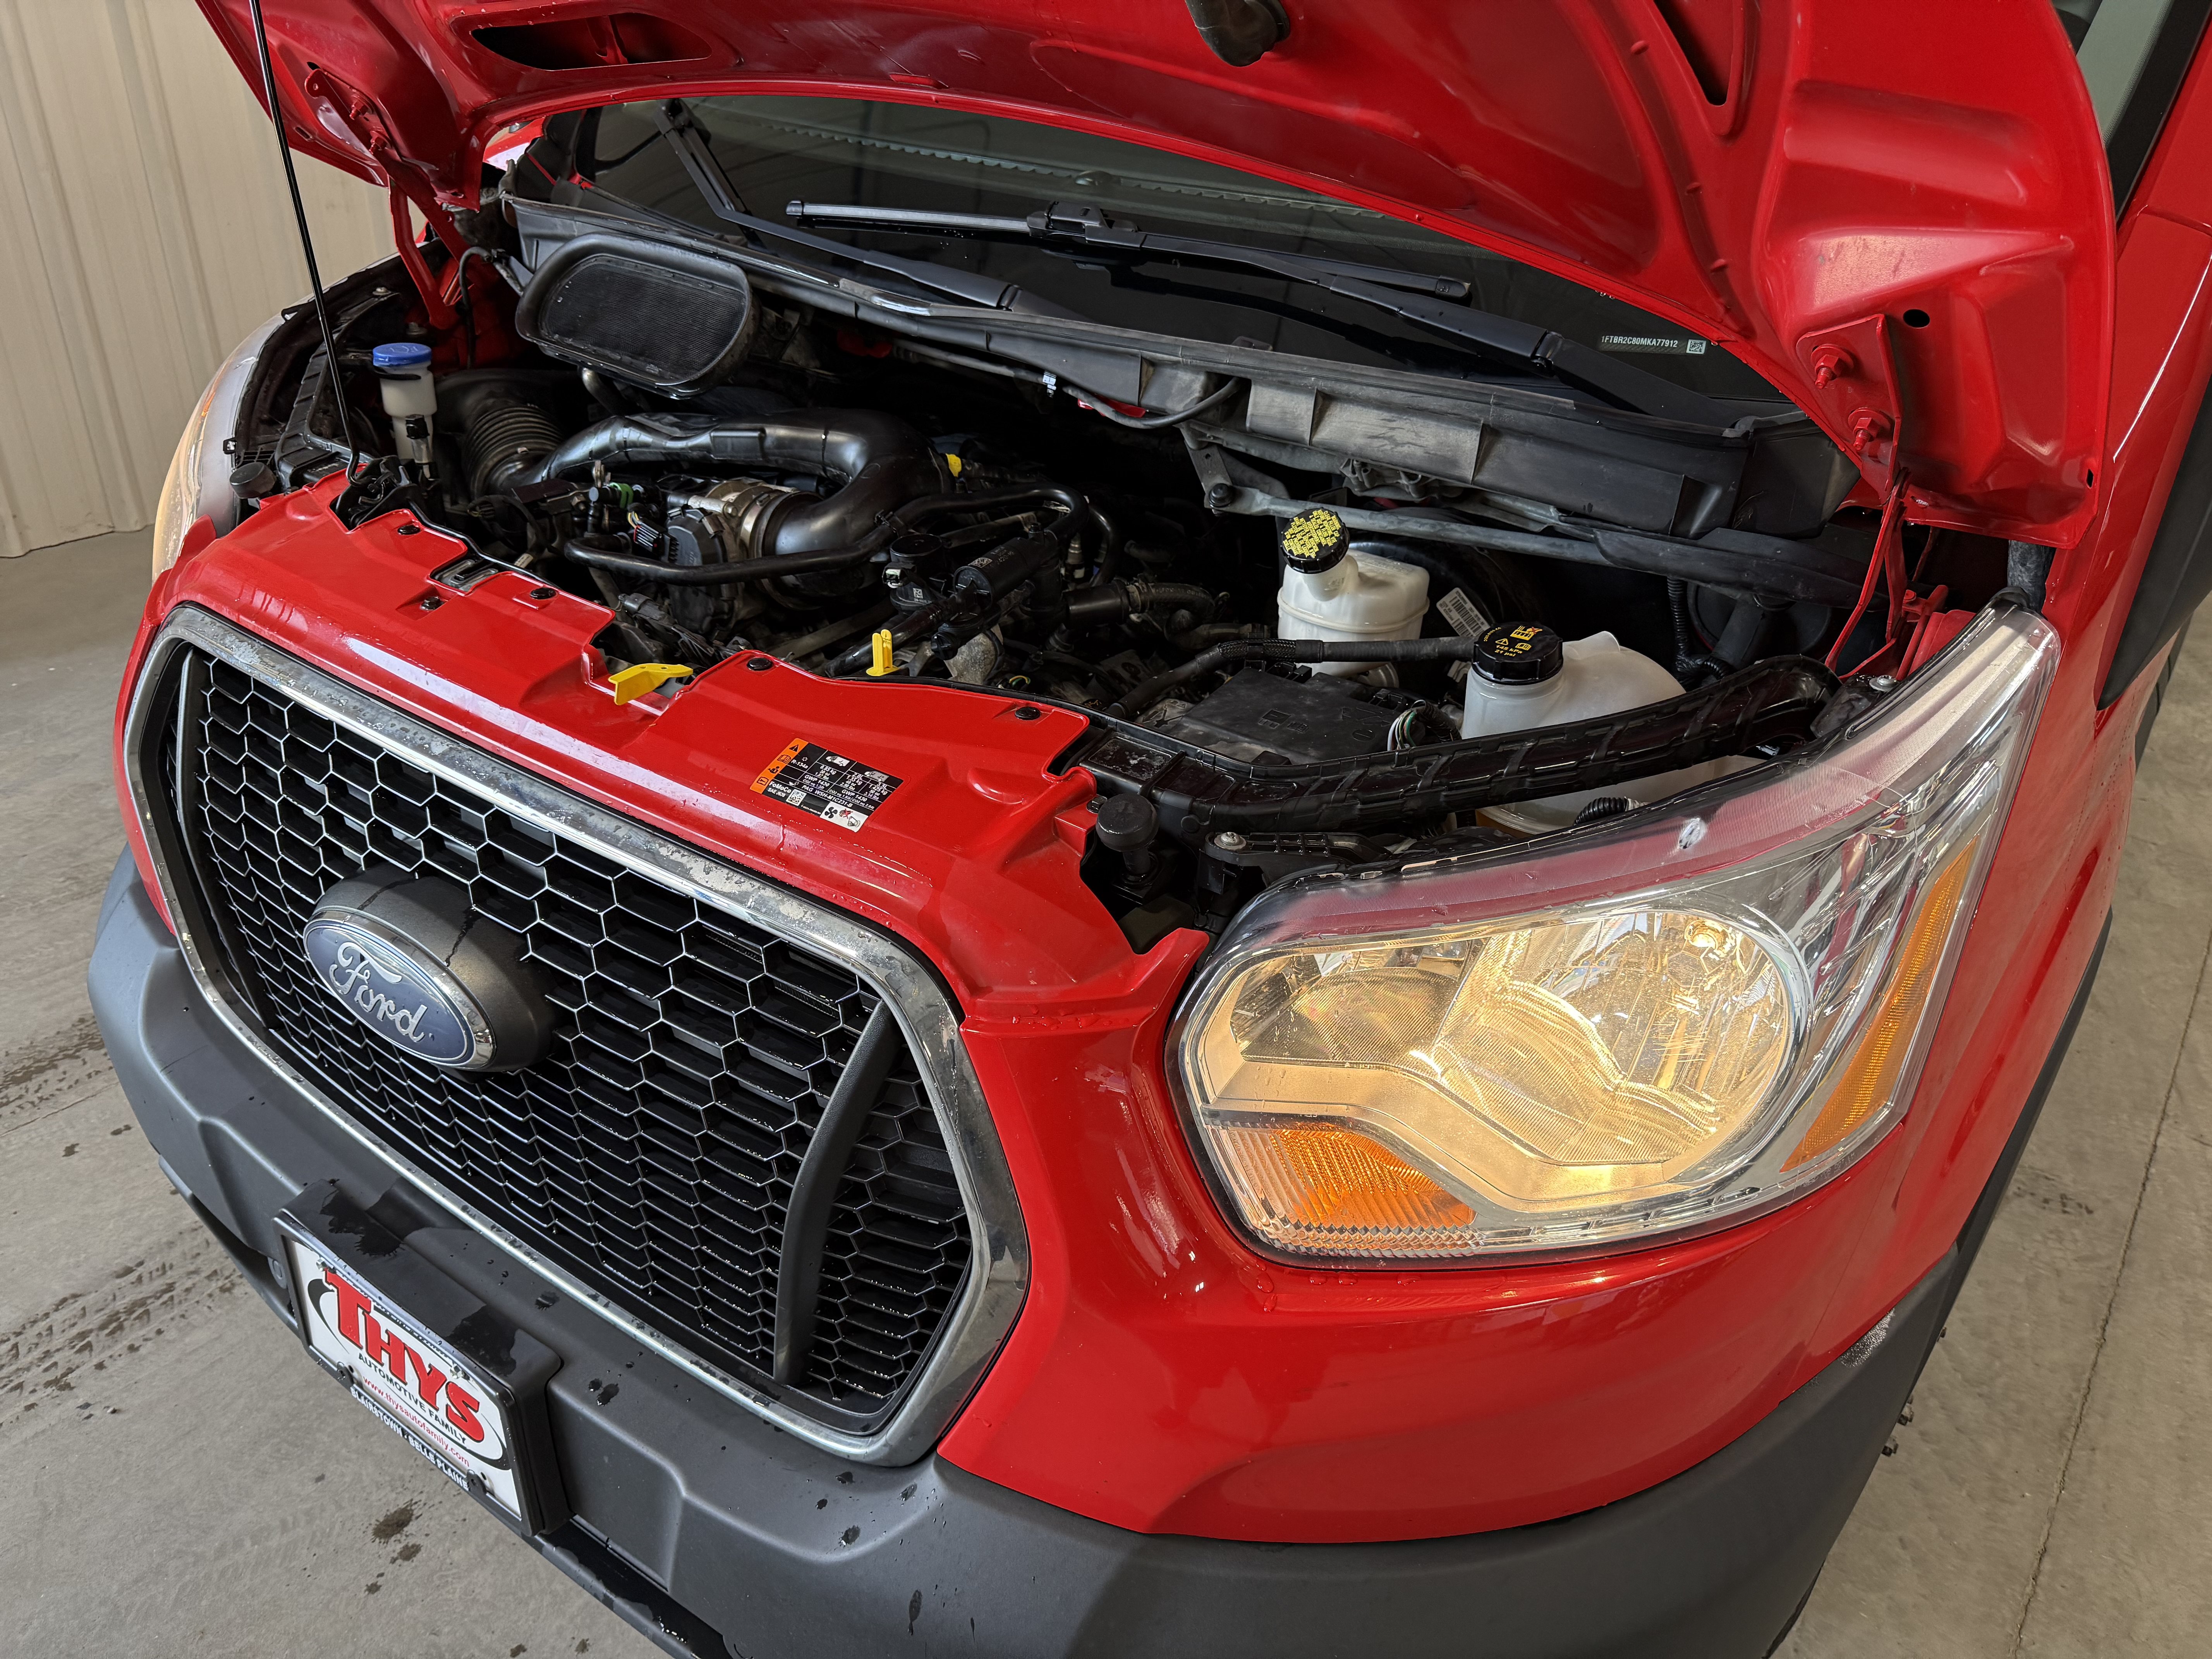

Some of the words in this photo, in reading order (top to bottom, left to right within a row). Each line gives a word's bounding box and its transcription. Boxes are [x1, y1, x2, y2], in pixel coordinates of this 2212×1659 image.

[1601, 335, 1678, 347] 1FTBR2C80MKA77912
[769, 781, 792, 793] FoMoCo
[791, 759, 808, 769] R-134a
[814, 790, 853, 807] WSH-M1C231-B
[329, 942, 427, 1042] Ford
[325, 1267, 485, 1443] THYS
[358, 1353, 426, 1413] AUTOMOTIVE
[428, 1408, 466, 1444] FAMILY
[350, 1386, 403, 1437] BLAIRSTOWN
[409, 1436, 436, 1465] BELLE
[437, 1462, 469, 1492] PLAINE
[363, 1376, 470, 1468] www.thysautofamily.com
